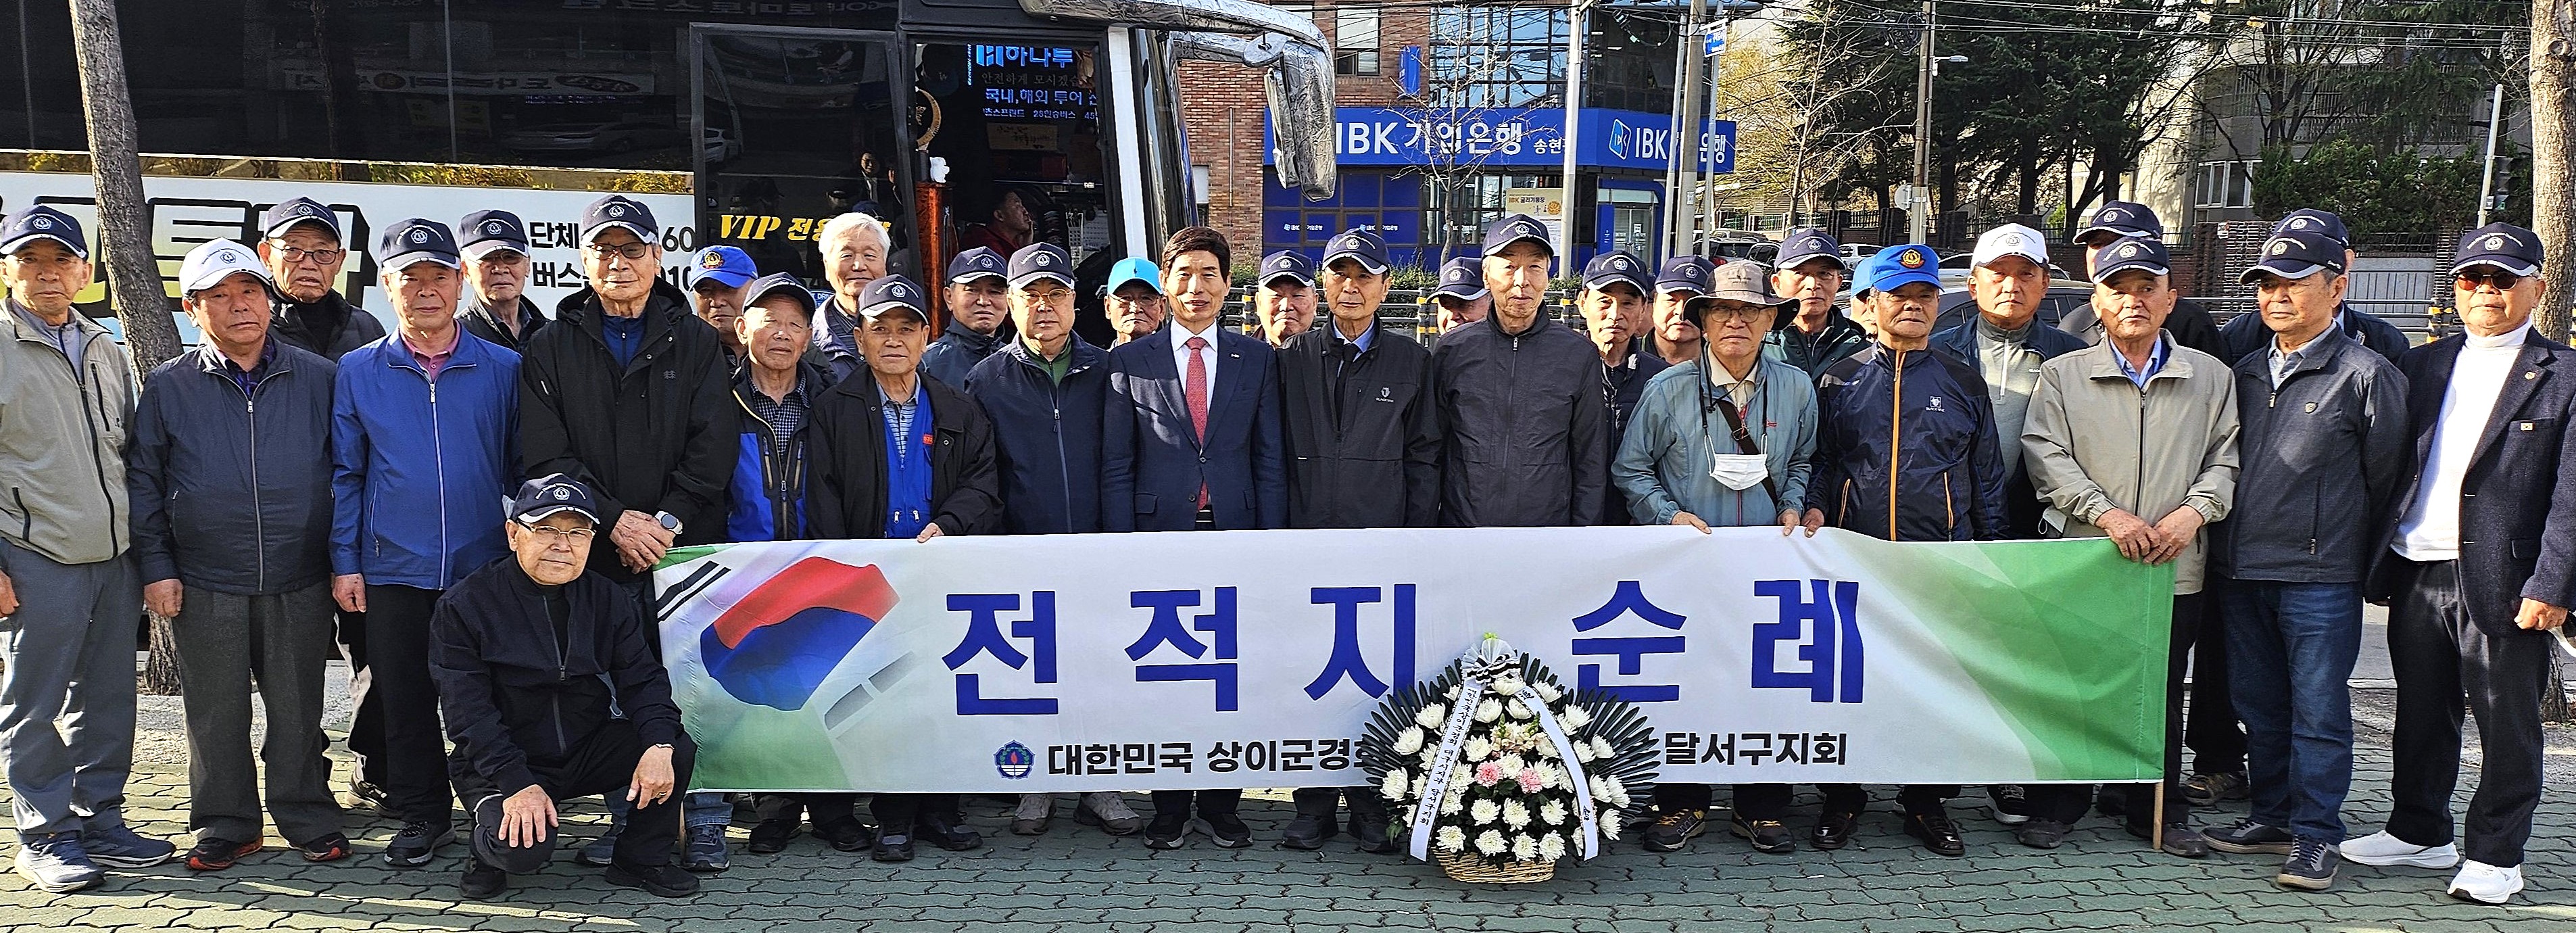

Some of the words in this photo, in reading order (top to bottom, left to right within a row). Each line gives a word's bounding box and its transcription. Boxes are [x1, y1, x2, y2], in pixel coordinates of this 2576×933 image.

[981, 72, 1028, 85] 안전하게
[1054, 91, 1082, 105] 투어
[1336, 122, 1399, 155] IBK
[1404, 122, 1522, 156] 기업은행
[1533, 138, 1565, 154] 송현
[1635, 127, 1668, 160] IBK
[529, 221, 579, 249] 단체
[721, 214, 781, 239] VIP
[533, 262, 589, 288] 버스
[1048, 740, 1194, 778] 대한민국
[1665, 733, 1847, 768] 달서구지회
